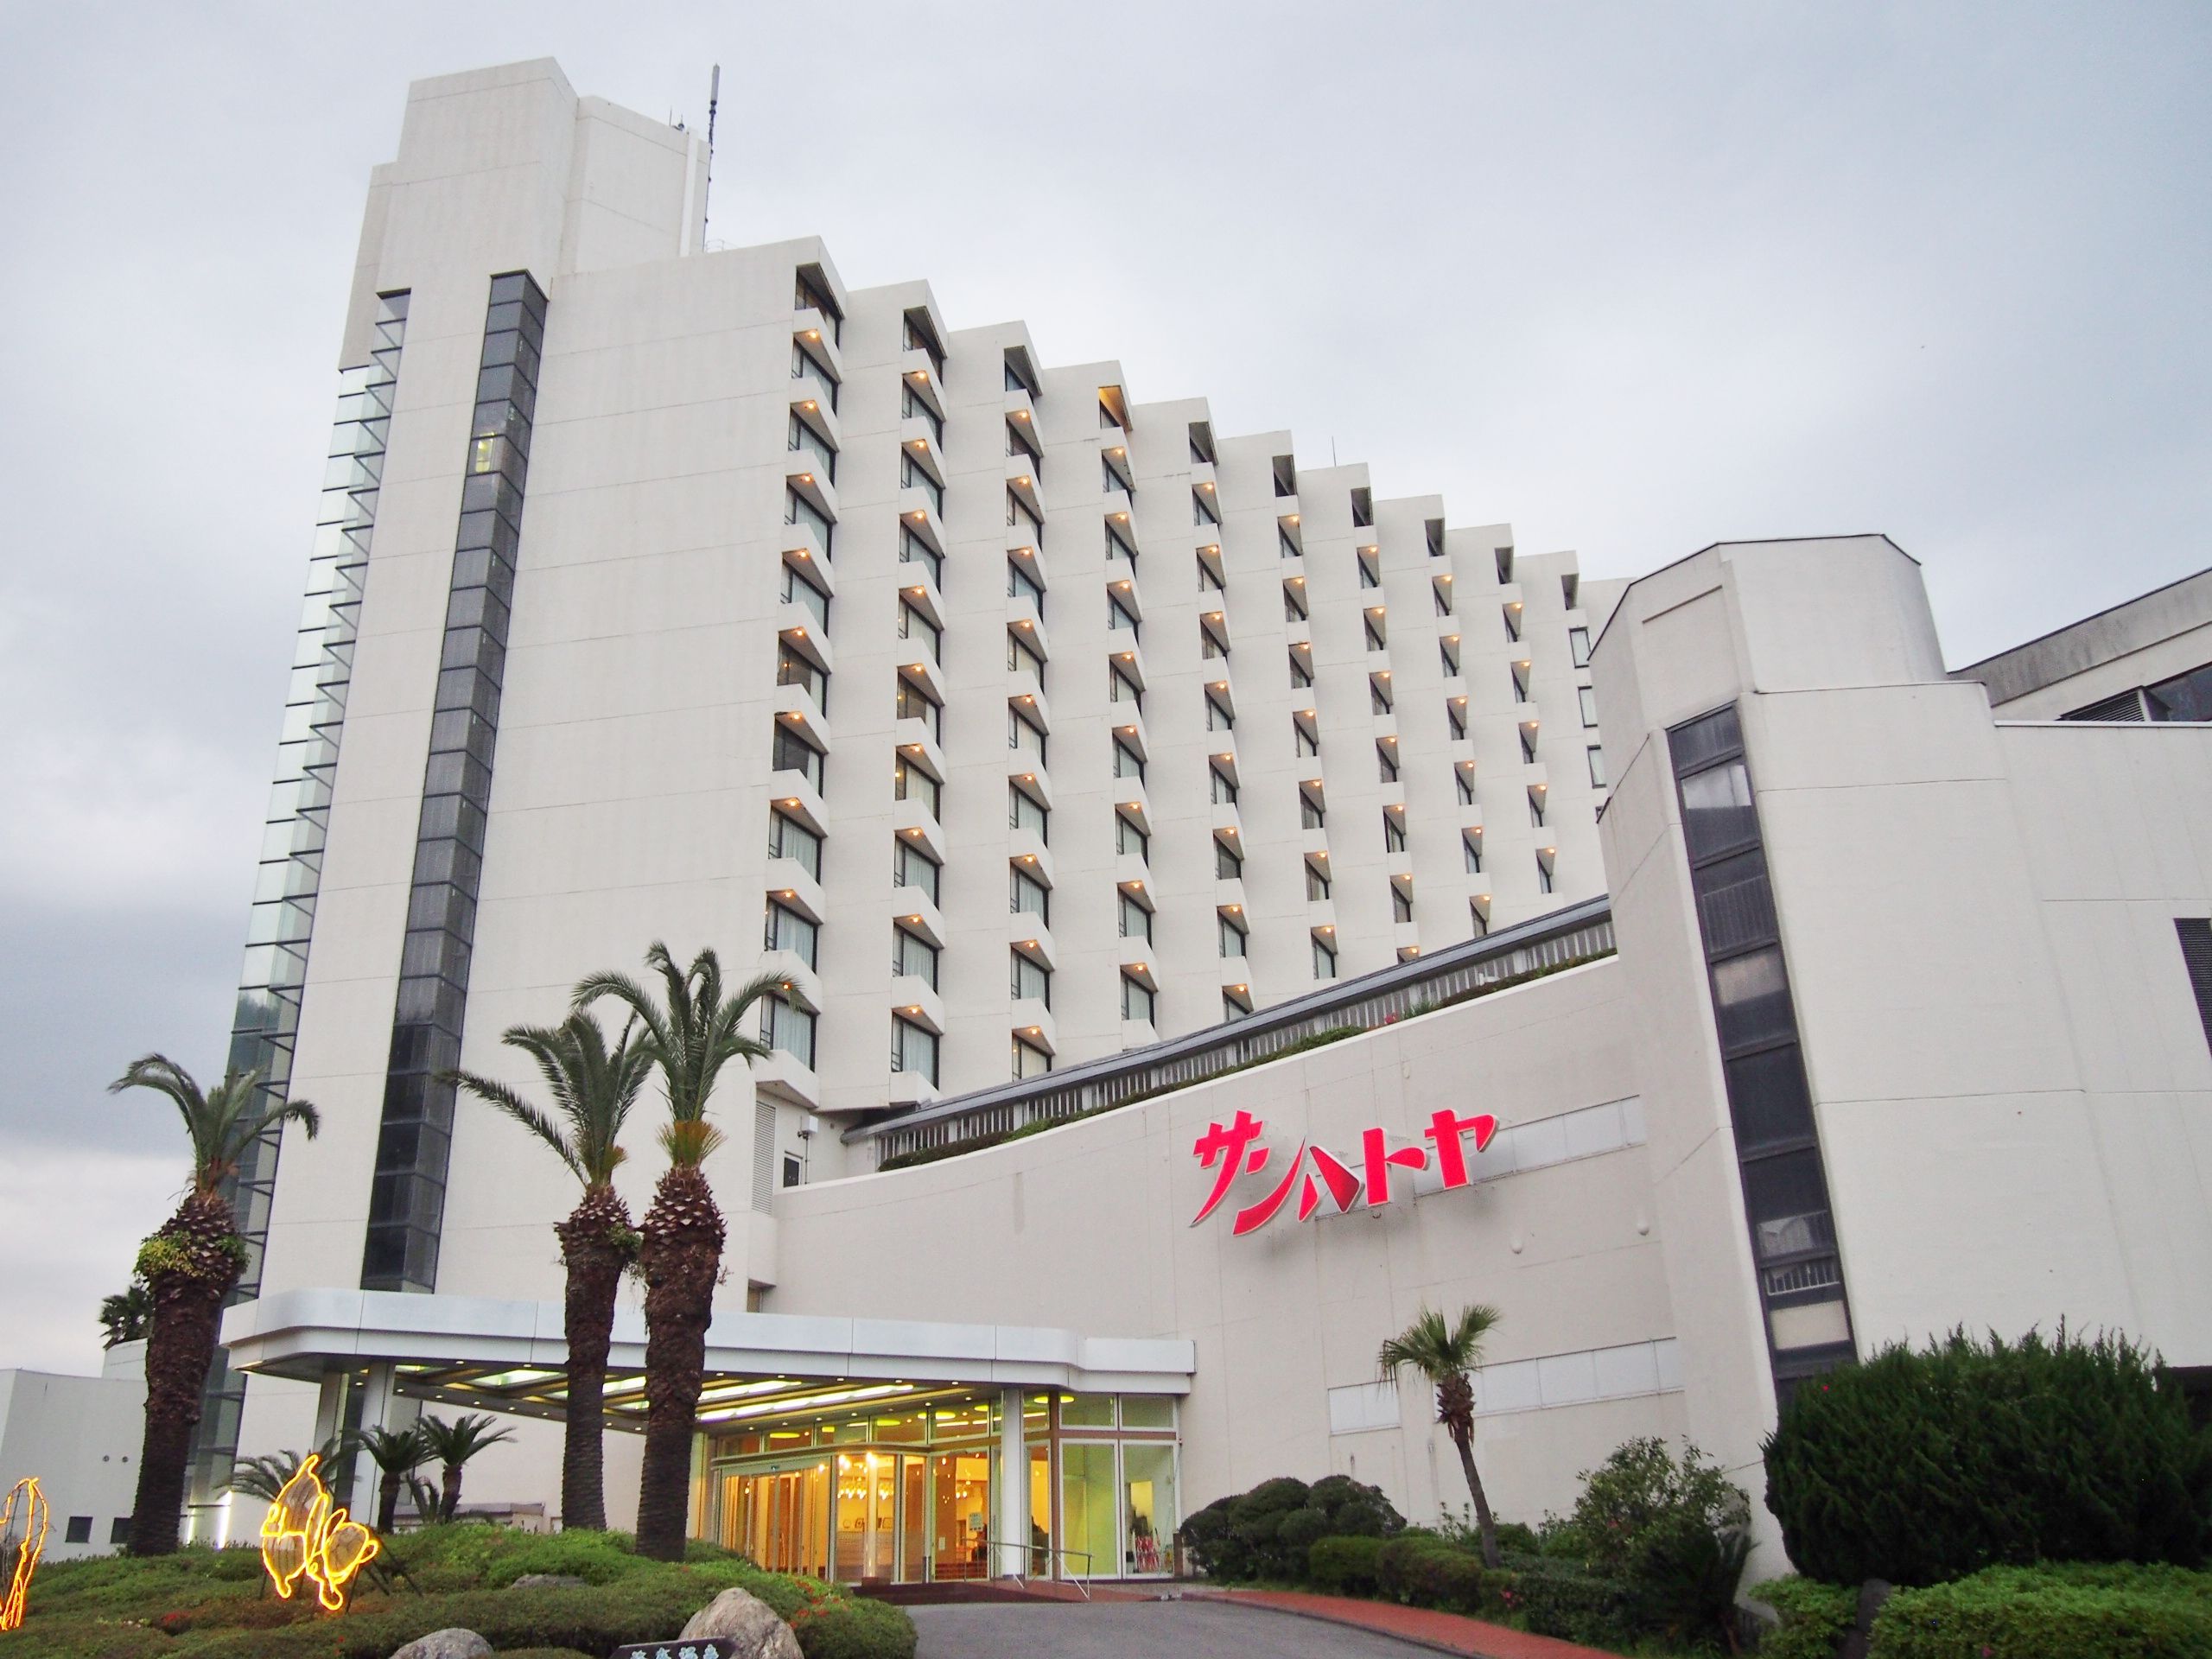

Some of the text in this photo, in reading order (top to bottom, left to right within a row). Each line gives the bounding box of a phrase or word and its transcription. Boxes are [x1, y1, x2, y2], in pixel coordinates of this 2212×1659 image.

[1190, 1109, 1498, 1236] サンハトヤ
